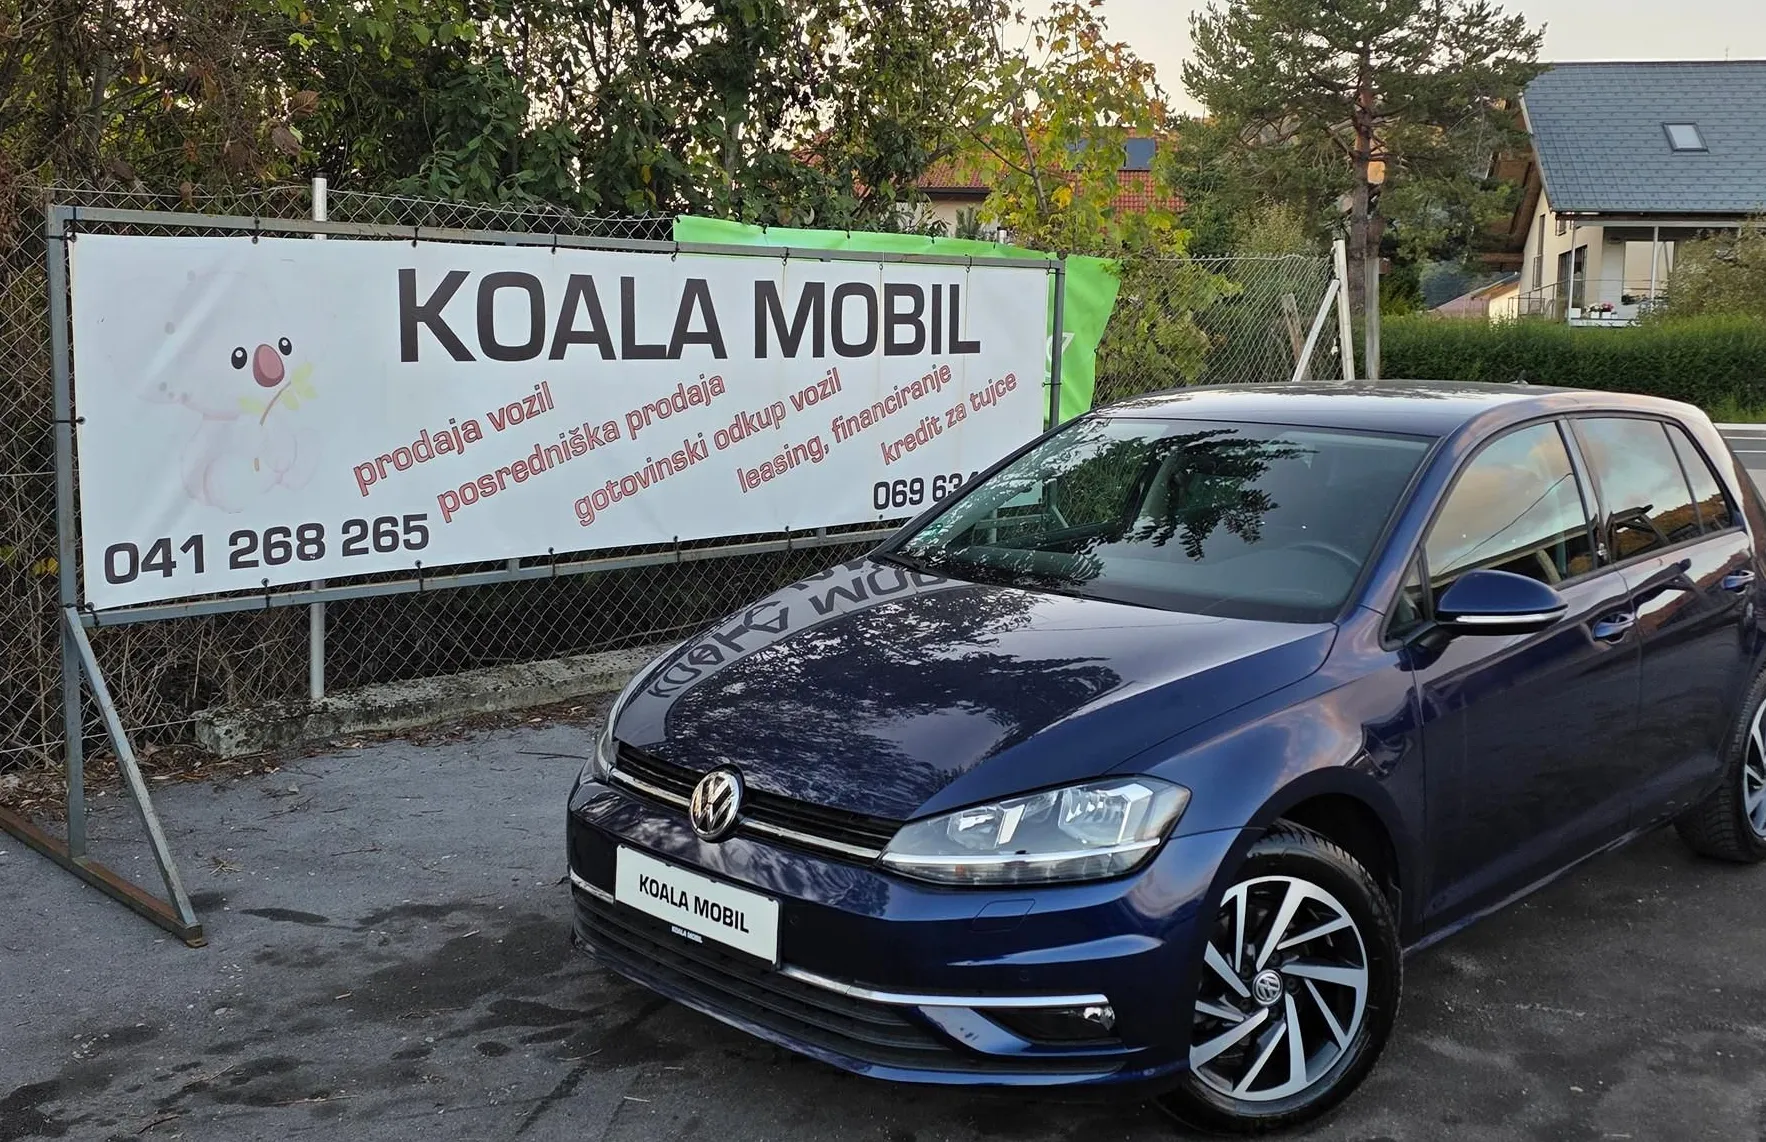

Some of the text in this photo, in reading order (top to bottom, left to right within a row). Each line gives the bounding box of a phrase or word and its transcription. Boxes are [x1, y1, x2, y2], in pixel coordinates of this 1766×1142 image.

[398, 268, 981, 362] KOALA MOBIL
[353, 380, 555, 497] prodaja vozil
[436, 373, 726, 524] posredniška prodaja
[574, 366, 842, 527] gotovinski odkup vozil
[736, 363, 952, 494] leasing, financiranje
[880, 371, 1018, 466] kredit za tujce
[873, 477, 925, 510] 069
[104, 513, 430, 585] 041 268 265
[639, 873, 750, 934] KOALA MOBIL
